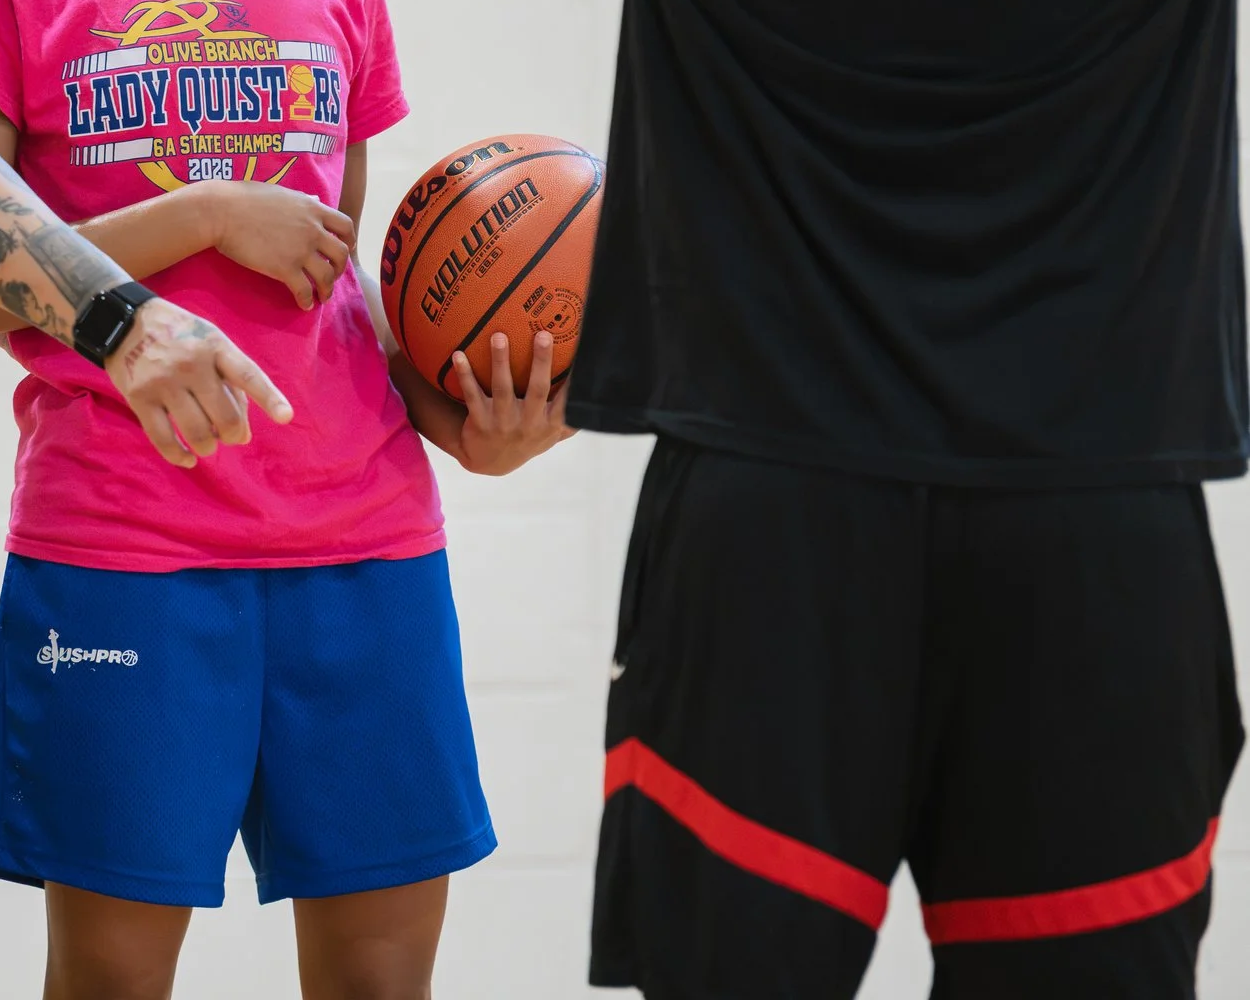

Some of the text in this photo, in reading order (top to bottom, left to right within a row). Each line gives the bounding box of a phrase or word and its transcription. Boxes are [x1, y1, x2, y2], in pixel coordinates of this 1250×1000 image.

[147, 39, 279, 65] OLIVE BRANCH
[63, 67, 171, 137] LADY
[152, 132, 283, 158] 6A STATE CHAMPS
[187, 157, 233, 181] 2026
[420, 177, 540, 324] EVOLUTION
[459, 233, 501, 283] MICROFIBER
[500, 195, 545, 233] COMPOSITE
